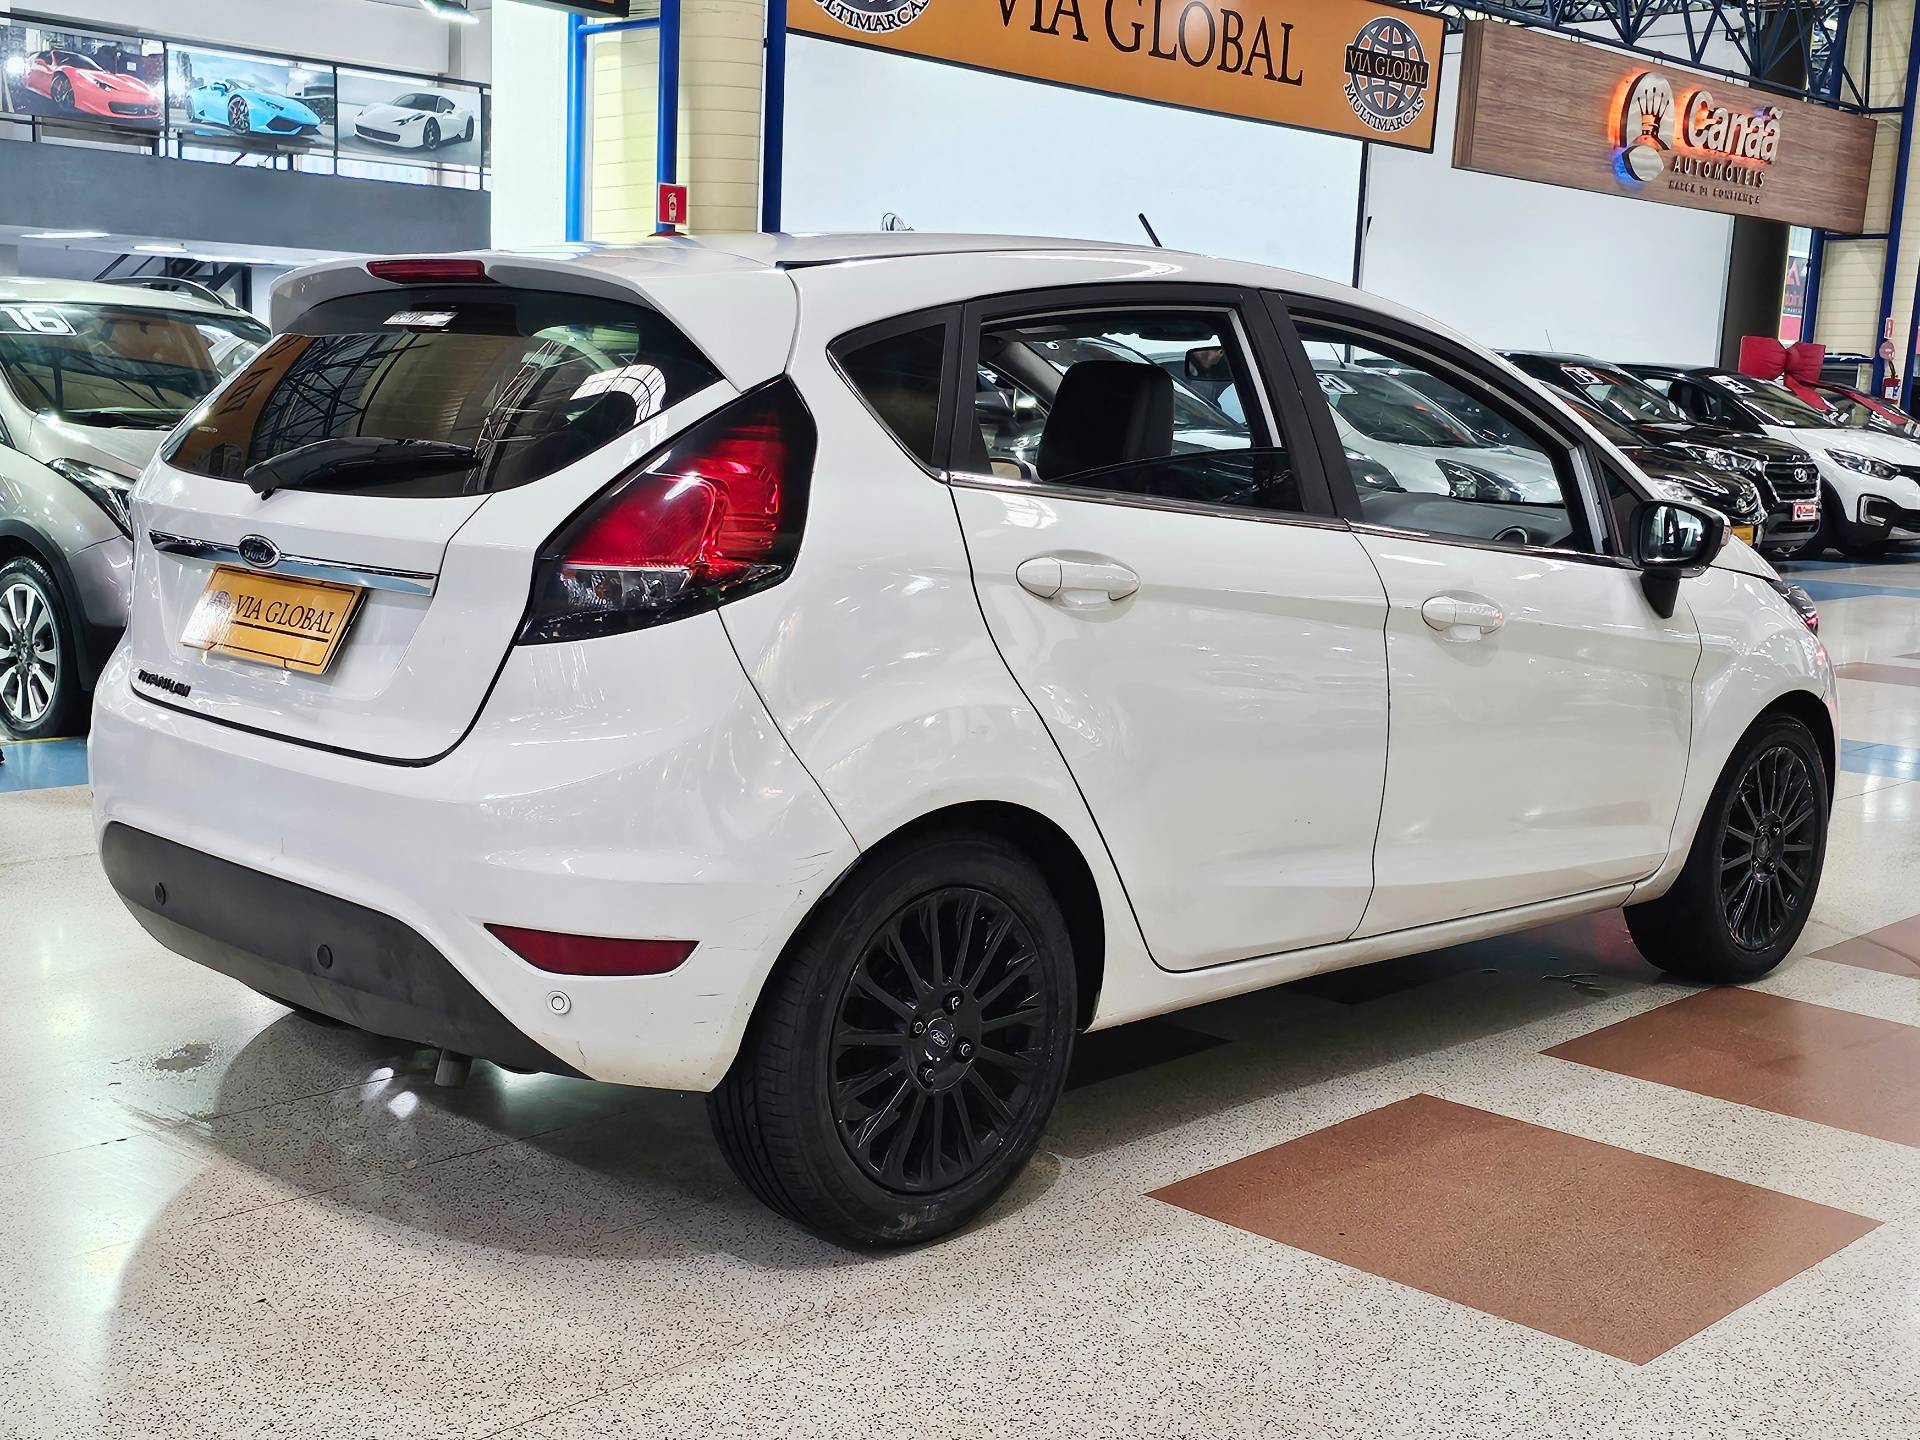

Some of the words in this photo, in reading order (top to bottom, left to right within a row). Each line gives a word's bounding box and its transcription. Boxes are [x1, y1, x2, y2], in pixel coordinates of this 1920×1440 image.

[1105, 0, 1303, 86] GLOBAL
[1348, 49, 1371, 73] VIA
[1375, 56, 1427, 84] GLOBAL
[1344, 81, 1424, 131] MULTIMARCAS
[1685, 90, 1783, 162] Canaã
[1673, 154, 1765, 188] AUTOMÓVEIS
[235, 594, 262, 620] VIA
[265, 601, 335, 634] GLOBAL
